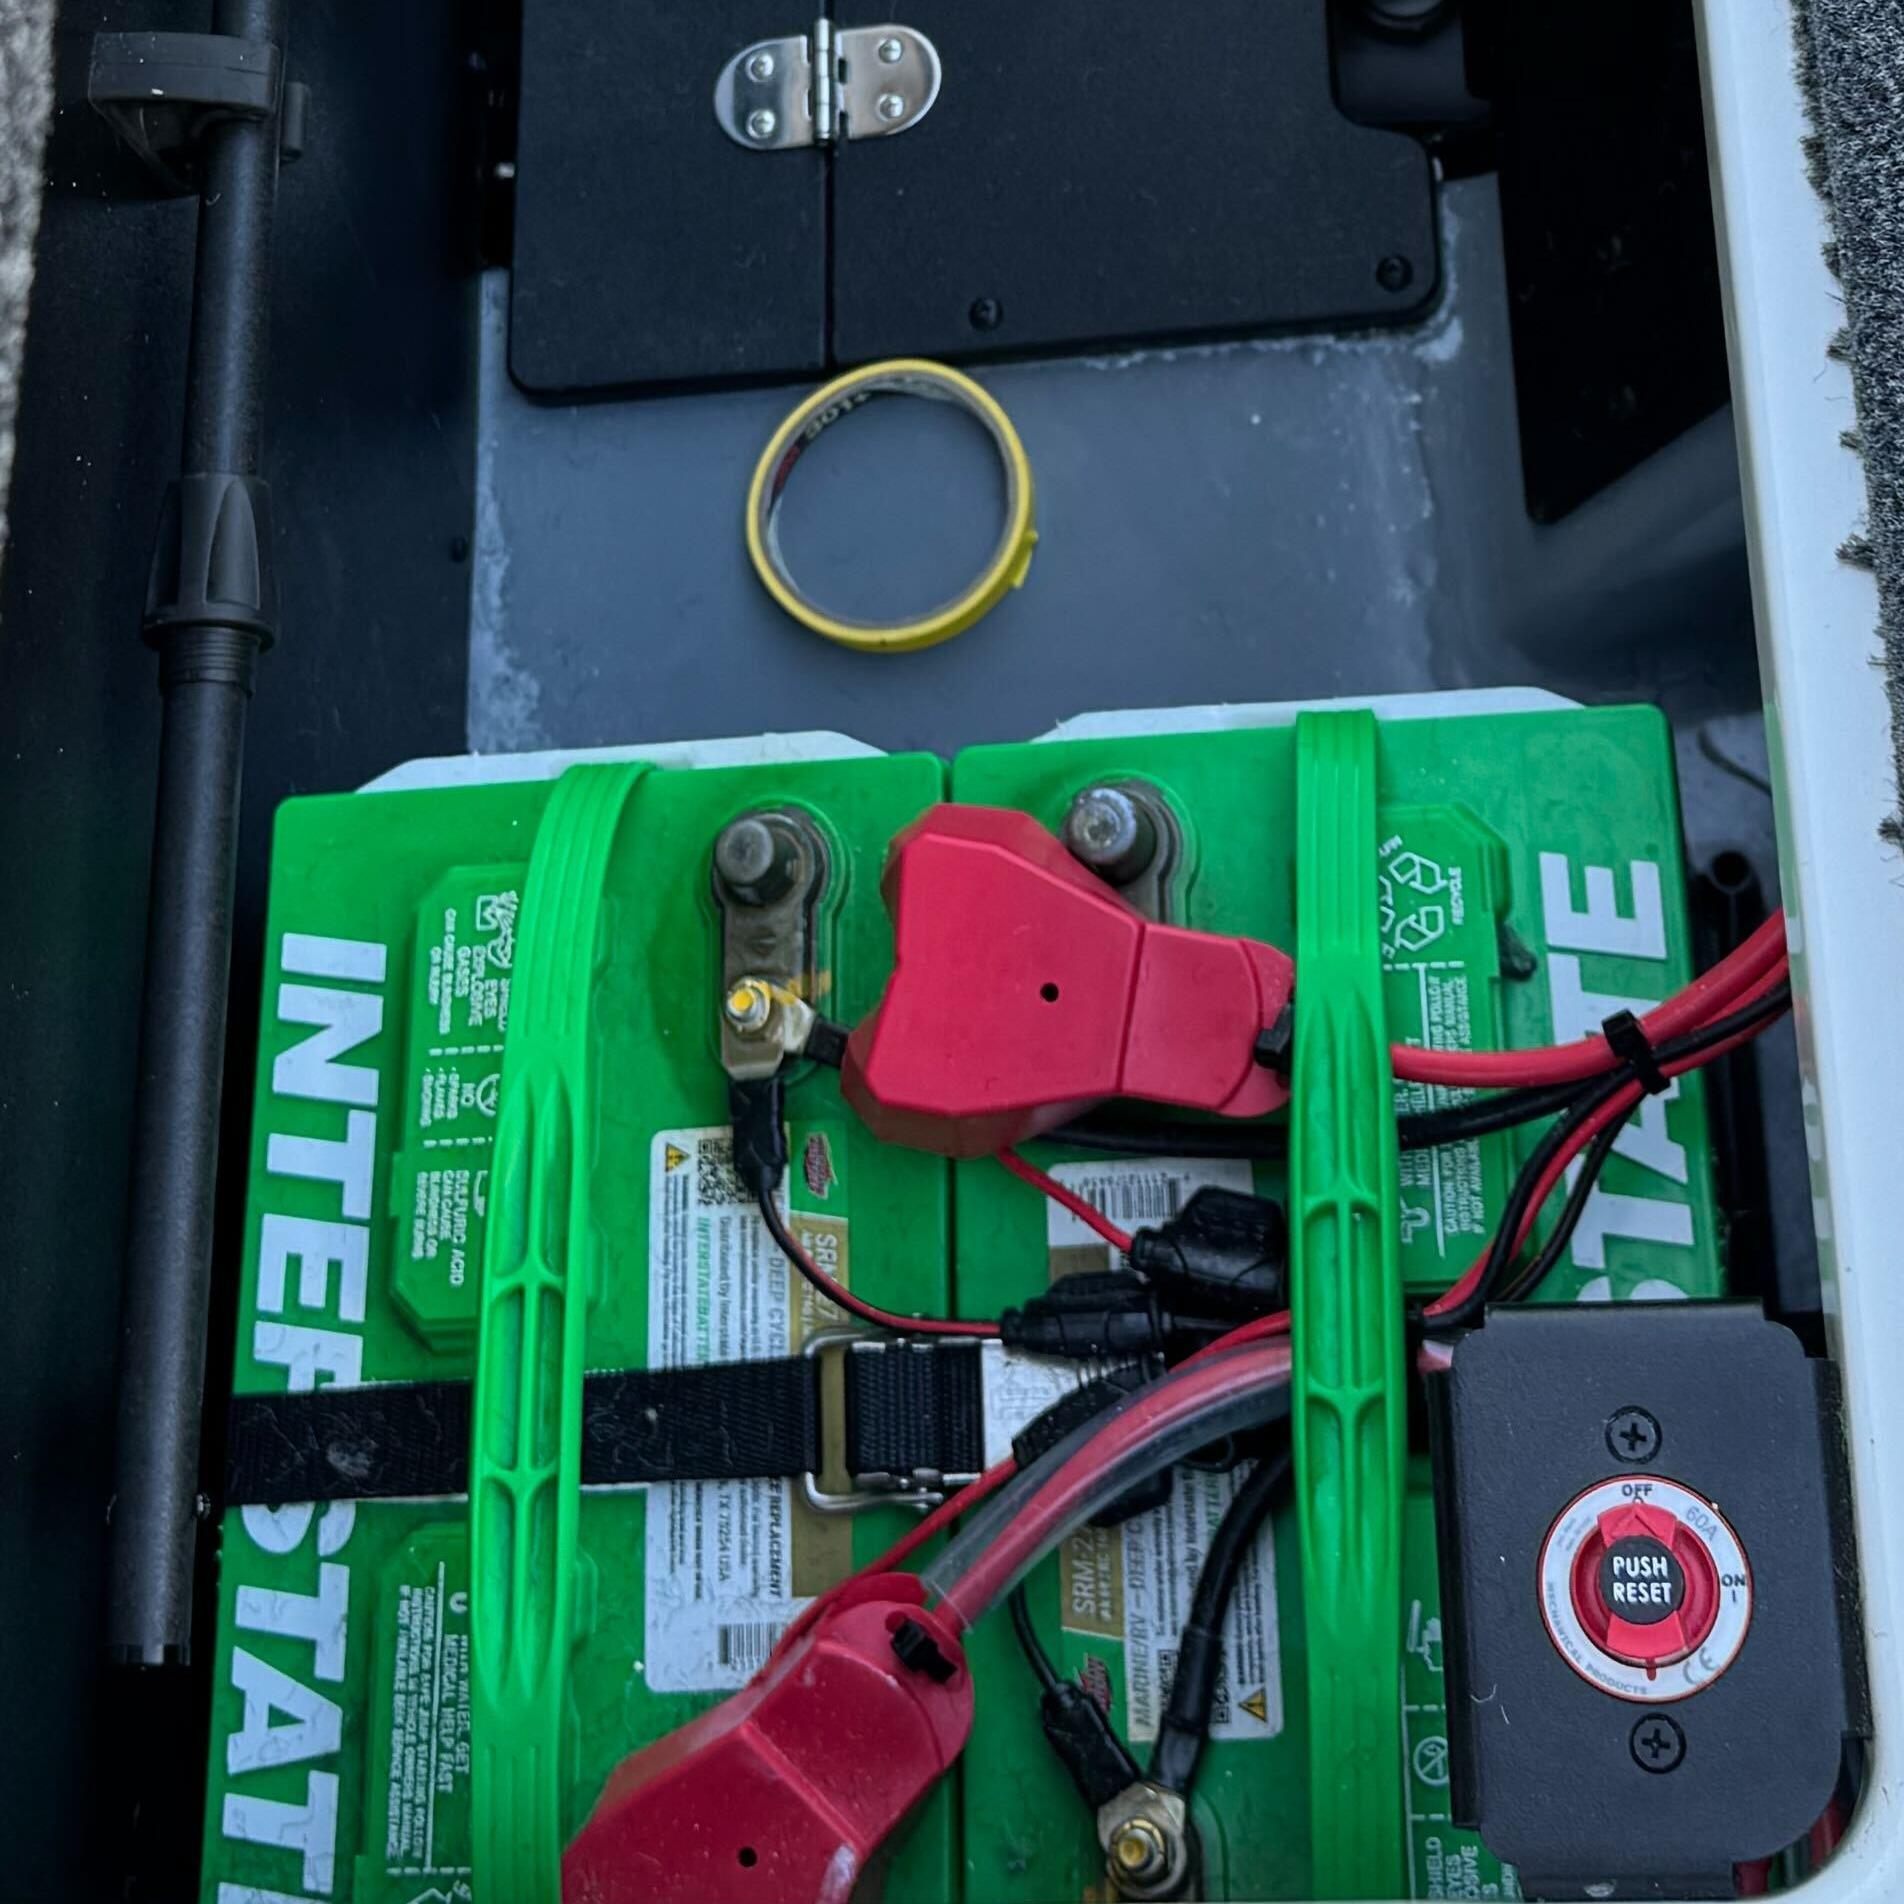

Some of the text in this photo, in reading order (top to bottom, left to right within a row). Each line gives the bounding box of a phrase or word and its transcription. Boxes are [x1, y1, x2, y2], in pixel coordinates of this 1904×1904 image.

[1450, 866, 1464, 925] RECYCLE
[455, 946, 471, 997] GASES
[468, 945, 486, 1026] EXPLOSIVE
[484, 978, 498, 1019] EYES
[461, 1082, 475, 1107] NO
[1414, 1148, 1431, 1186] MEDI
[440, 1170, 453, 1240] CAN CAUSE
[450, 1170, 470, 1286] SULFURIC ACID
[769, 1257, 786, 1360] DEEP CYCL
[719, 1494, 731, 1510] TX
[1622, 1484, 1653, 1496] OFF
[1182, 1482, 1197, 1544] Interstate
[1686, 1506, 1719, 1541] 60A
[719, 1554, 731, 1581] USA
[769, 1496, 782, 1598] REPLACEMENT
[1127, 1541, 1146, 1589] DEEP
[1613, 1556, 1668, 1579] PUSH
[1613, 1582, 1672, 1604] RESET
[1722, 1574, 1746, 1586] ON
[398, 1600, 409, 1625] NOT
[1546, 1582, 1583, 1667] MECHANICAL
[1129, 1613, 1151, 1726] MARINE/RV
[1585, 1665, 1647, 1695] PRODUCTS
[437, 1634, 458, 1793] MEDICAL HELP FAST
[456, 1742, 470, 1775] GET
